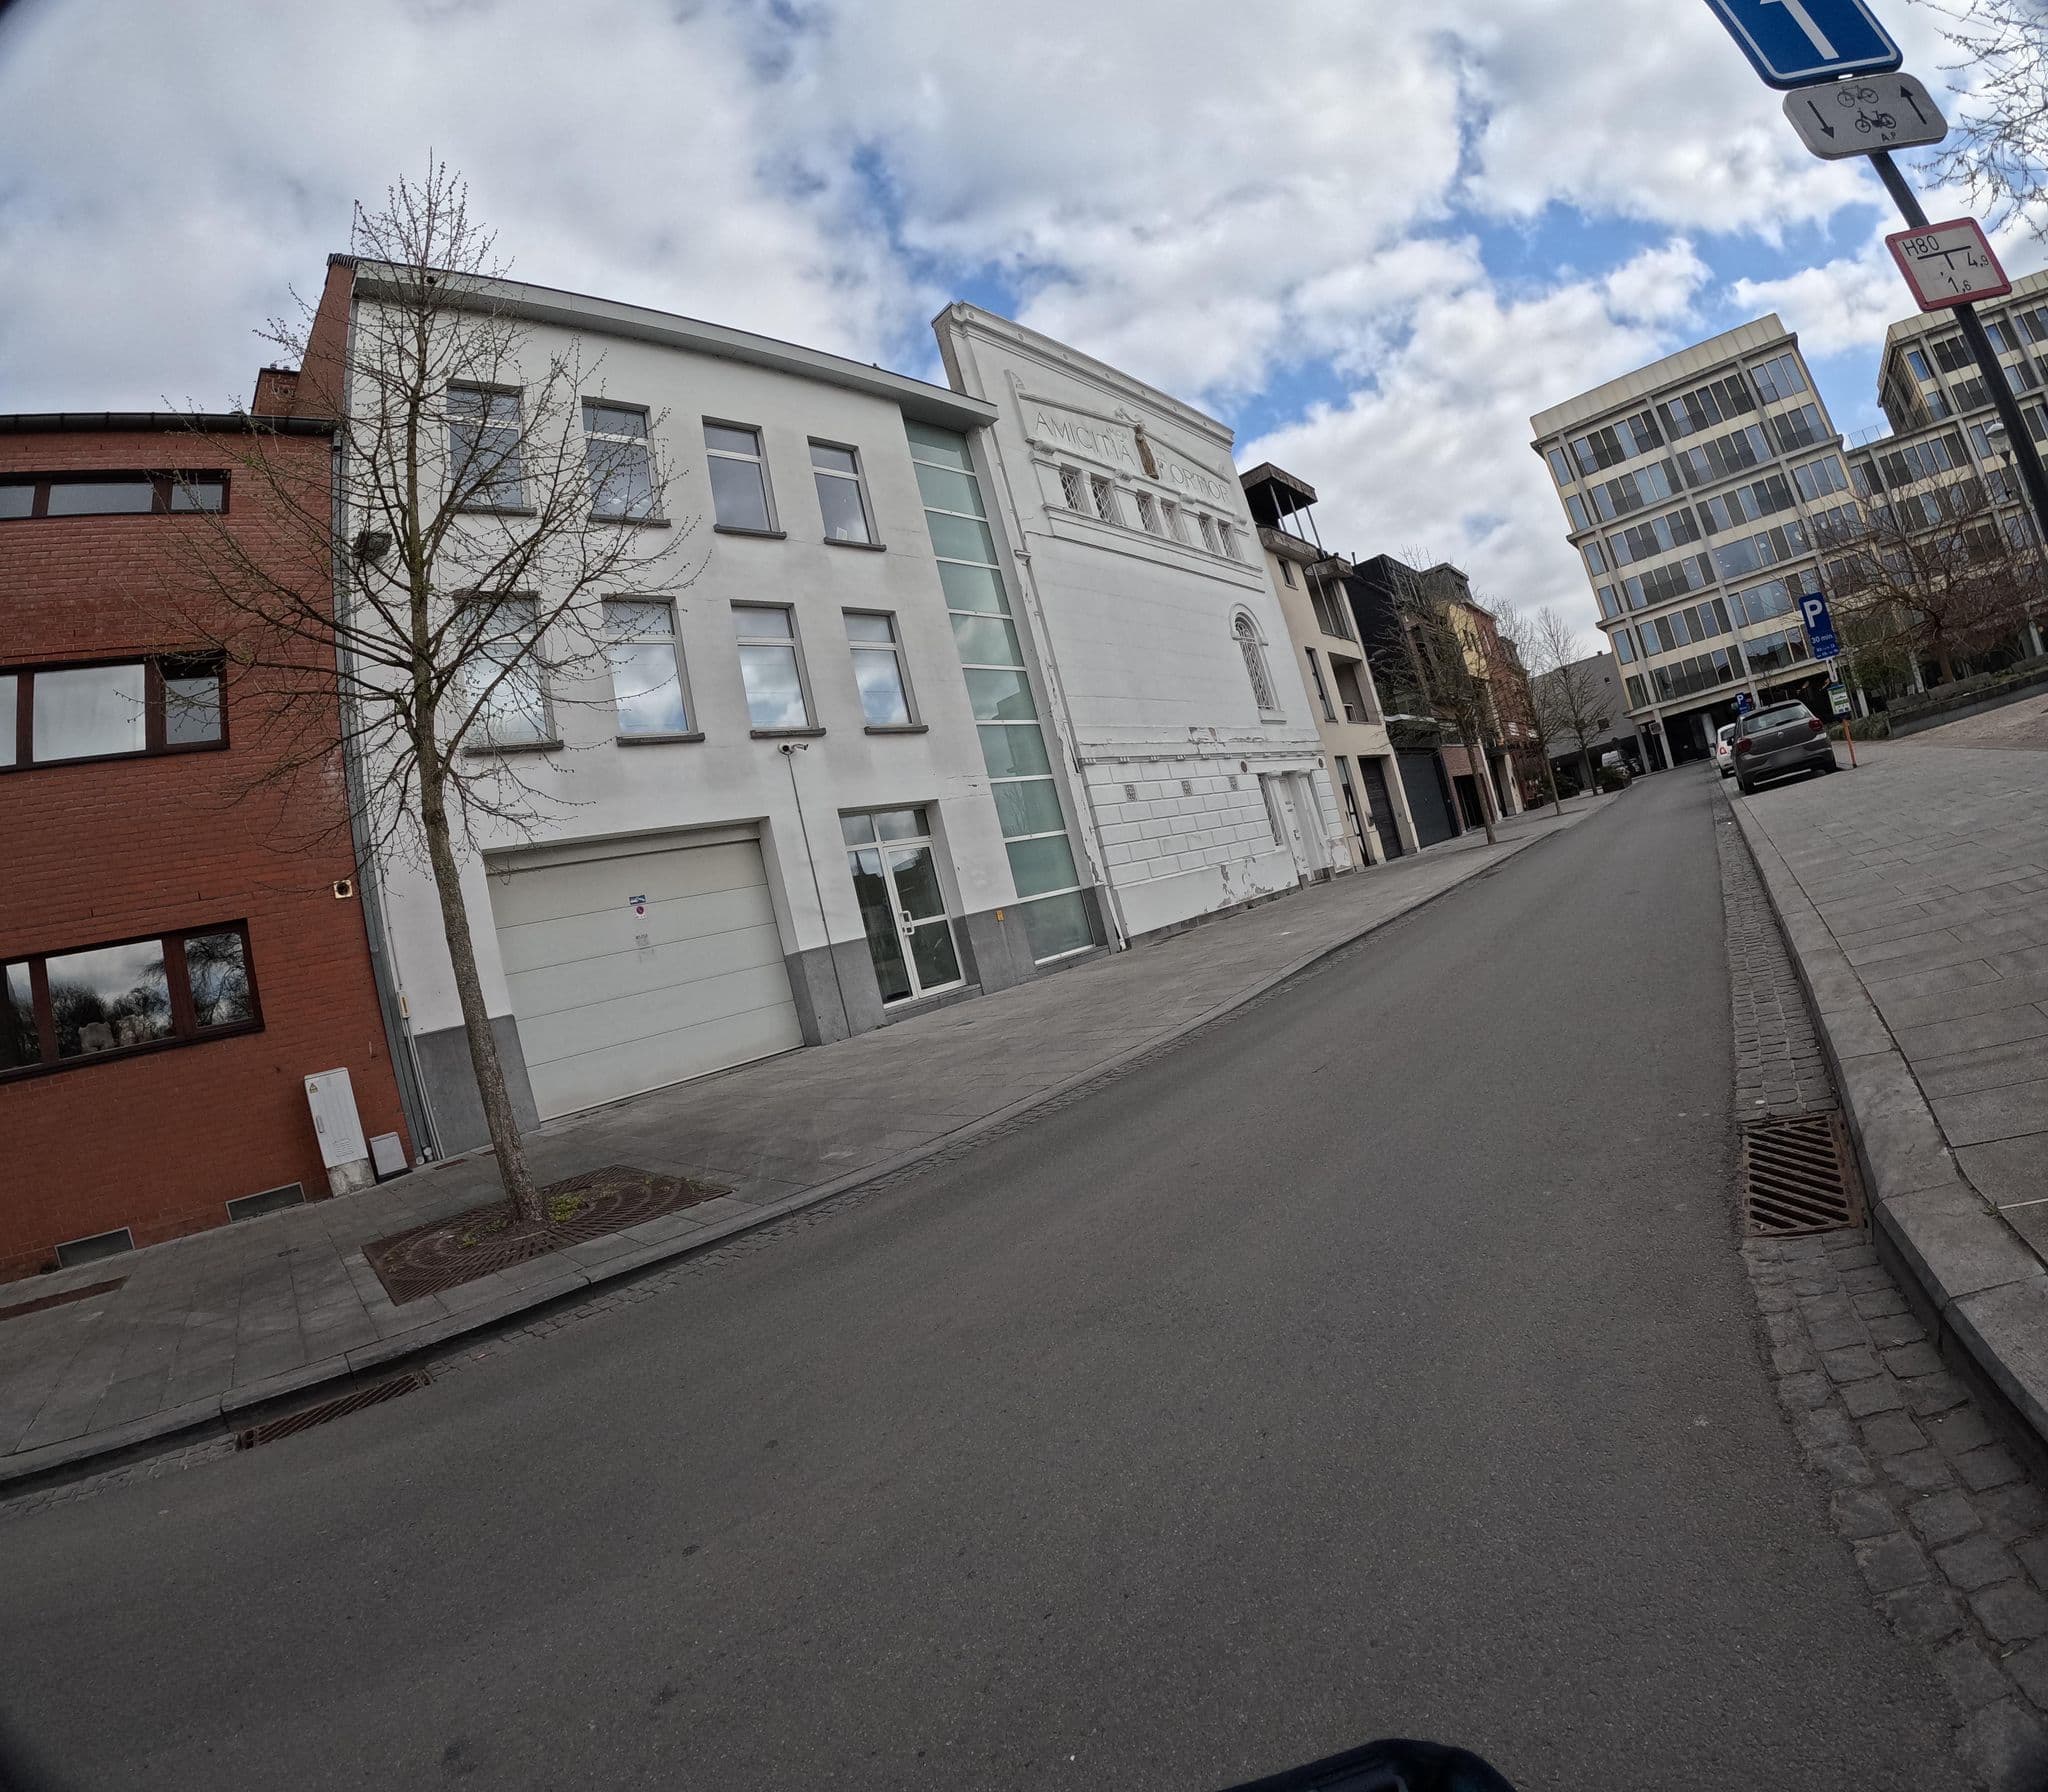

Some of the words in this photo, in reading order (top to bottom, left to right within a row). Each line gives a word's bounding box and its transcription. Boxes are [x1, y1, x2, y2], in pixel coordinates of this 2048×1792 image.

[1902, 235, 1940, 256] H80
[1036, 412, 1135, 466] AMICITIA
[1803, 599, 1823, 628] P
[1811, 636, 1821, 644] 30
[1736, 694, 1744, 705] P
